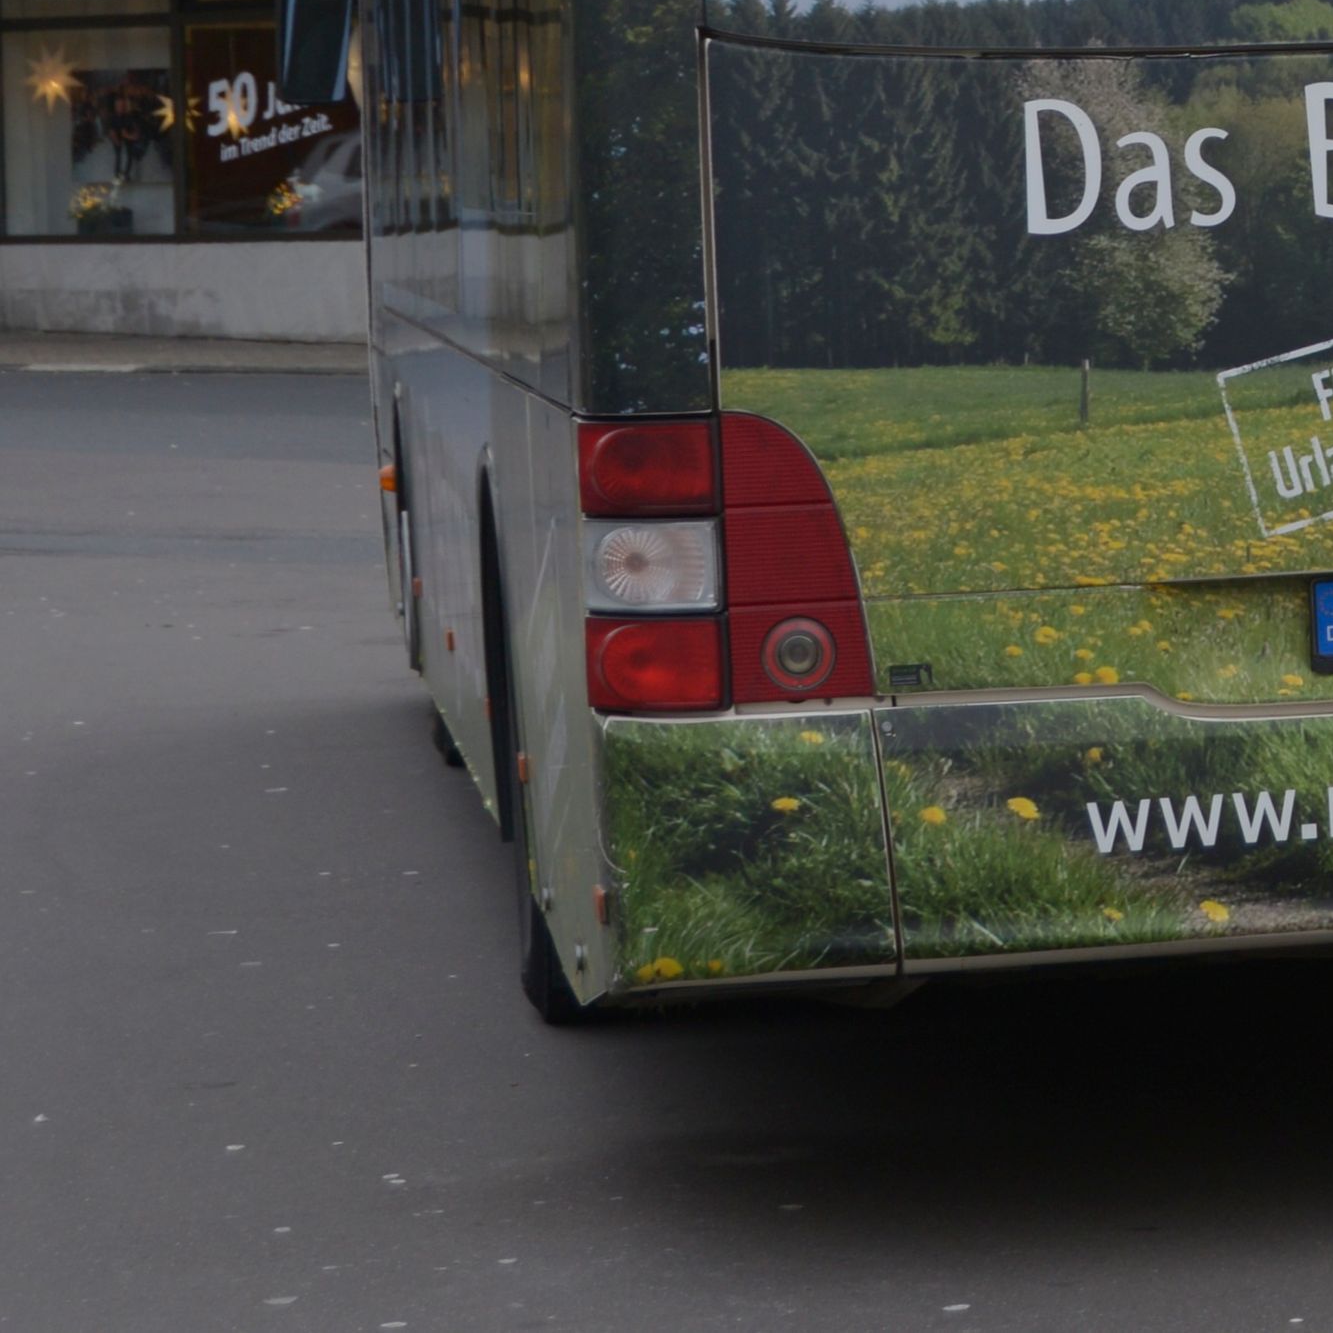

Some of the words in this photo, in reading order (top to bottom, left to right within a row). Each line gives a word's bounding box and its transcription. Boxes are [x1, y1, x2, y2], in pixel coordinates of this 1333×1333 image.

[206, 70, 259, 136] 50
[220, 142, 239, 162] im
[240, 126, 278, 156] Trend
[278, 122, 301, 144] der
[1023, 97, 1237, 236] Das
